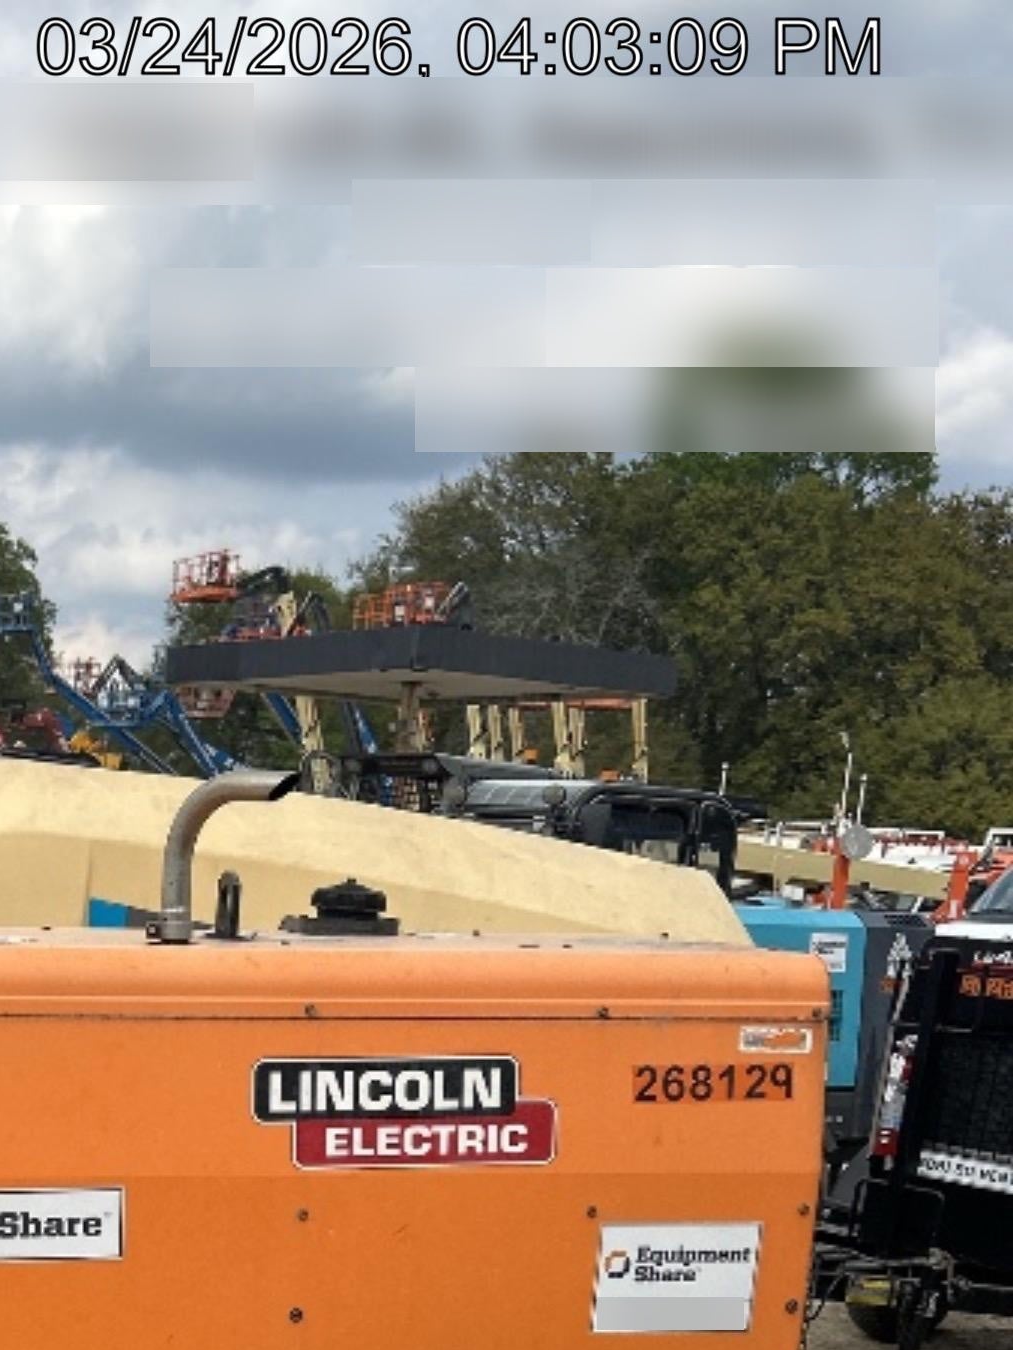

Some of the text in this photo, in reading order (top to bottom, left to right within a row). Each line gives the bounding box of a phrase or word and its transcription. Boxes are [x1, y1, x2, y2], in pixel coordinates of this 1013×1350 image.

[268, 1067, 502, 1113] LINCOLN
[634, 1062, 793, 1102] 268129
[325, 1123, 528, 1158] ELECTRIC
[634, 1245, 751, 1266] Equipment
[633, 1265, 697, 1282] Share
